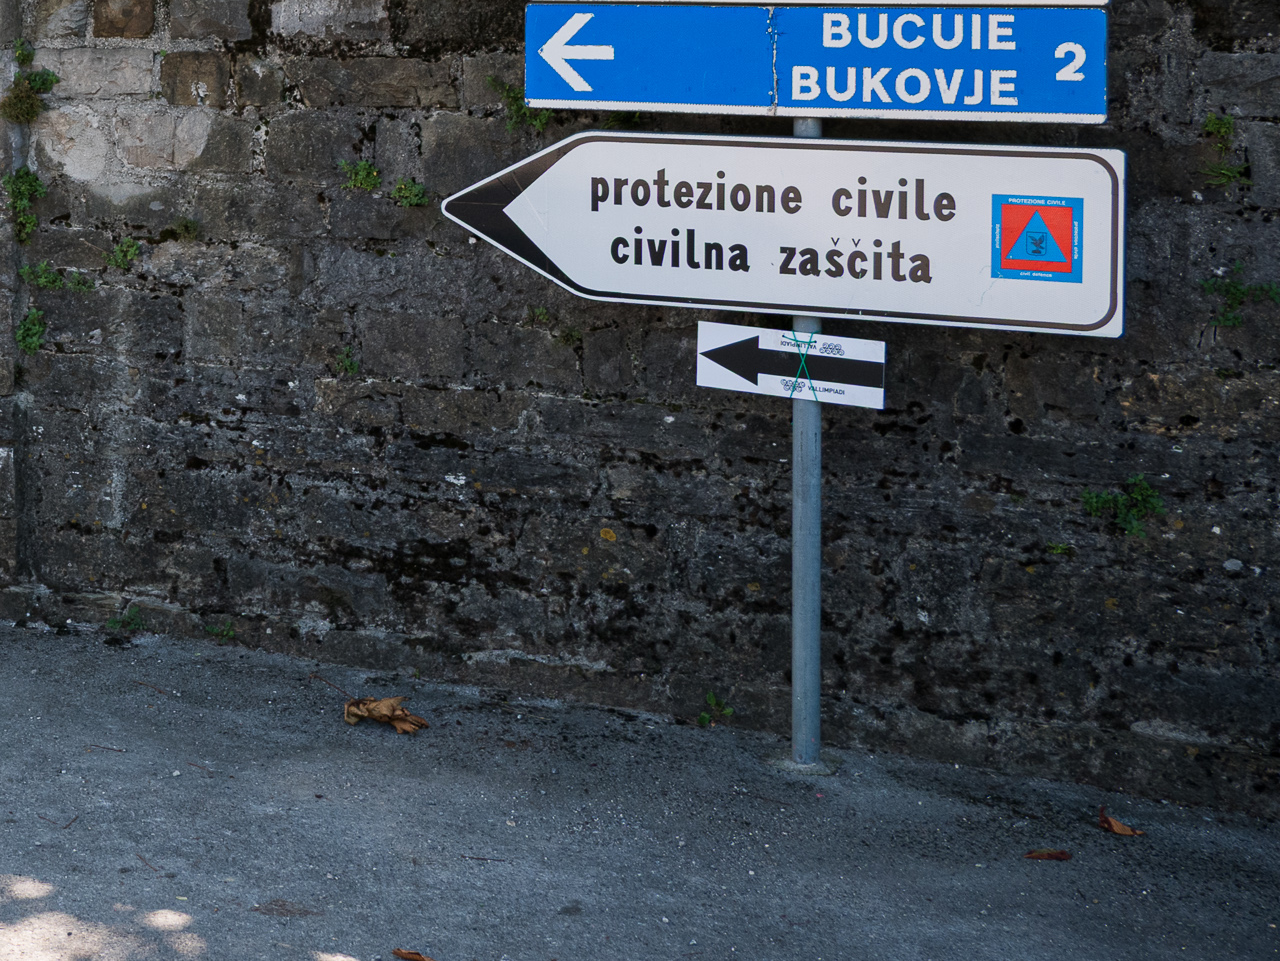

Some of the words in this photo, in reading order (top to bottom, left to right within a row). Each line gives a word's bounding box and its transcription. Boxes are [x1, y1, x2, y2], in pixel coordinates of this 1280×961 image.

[823, 13, 1016, 50] BUCUIE
[1055, 42, 1086, 81] 2
[791, 66, 1018, 105] BUKOVJE
[591, 168, 802, 214] protezione
[831, 176, 956, 221] civile
[611, 226, 751, 272] civilna
[779, 237, 933, 283] zaščita
[808, 385, 845, 395] VALLIMPIADI
